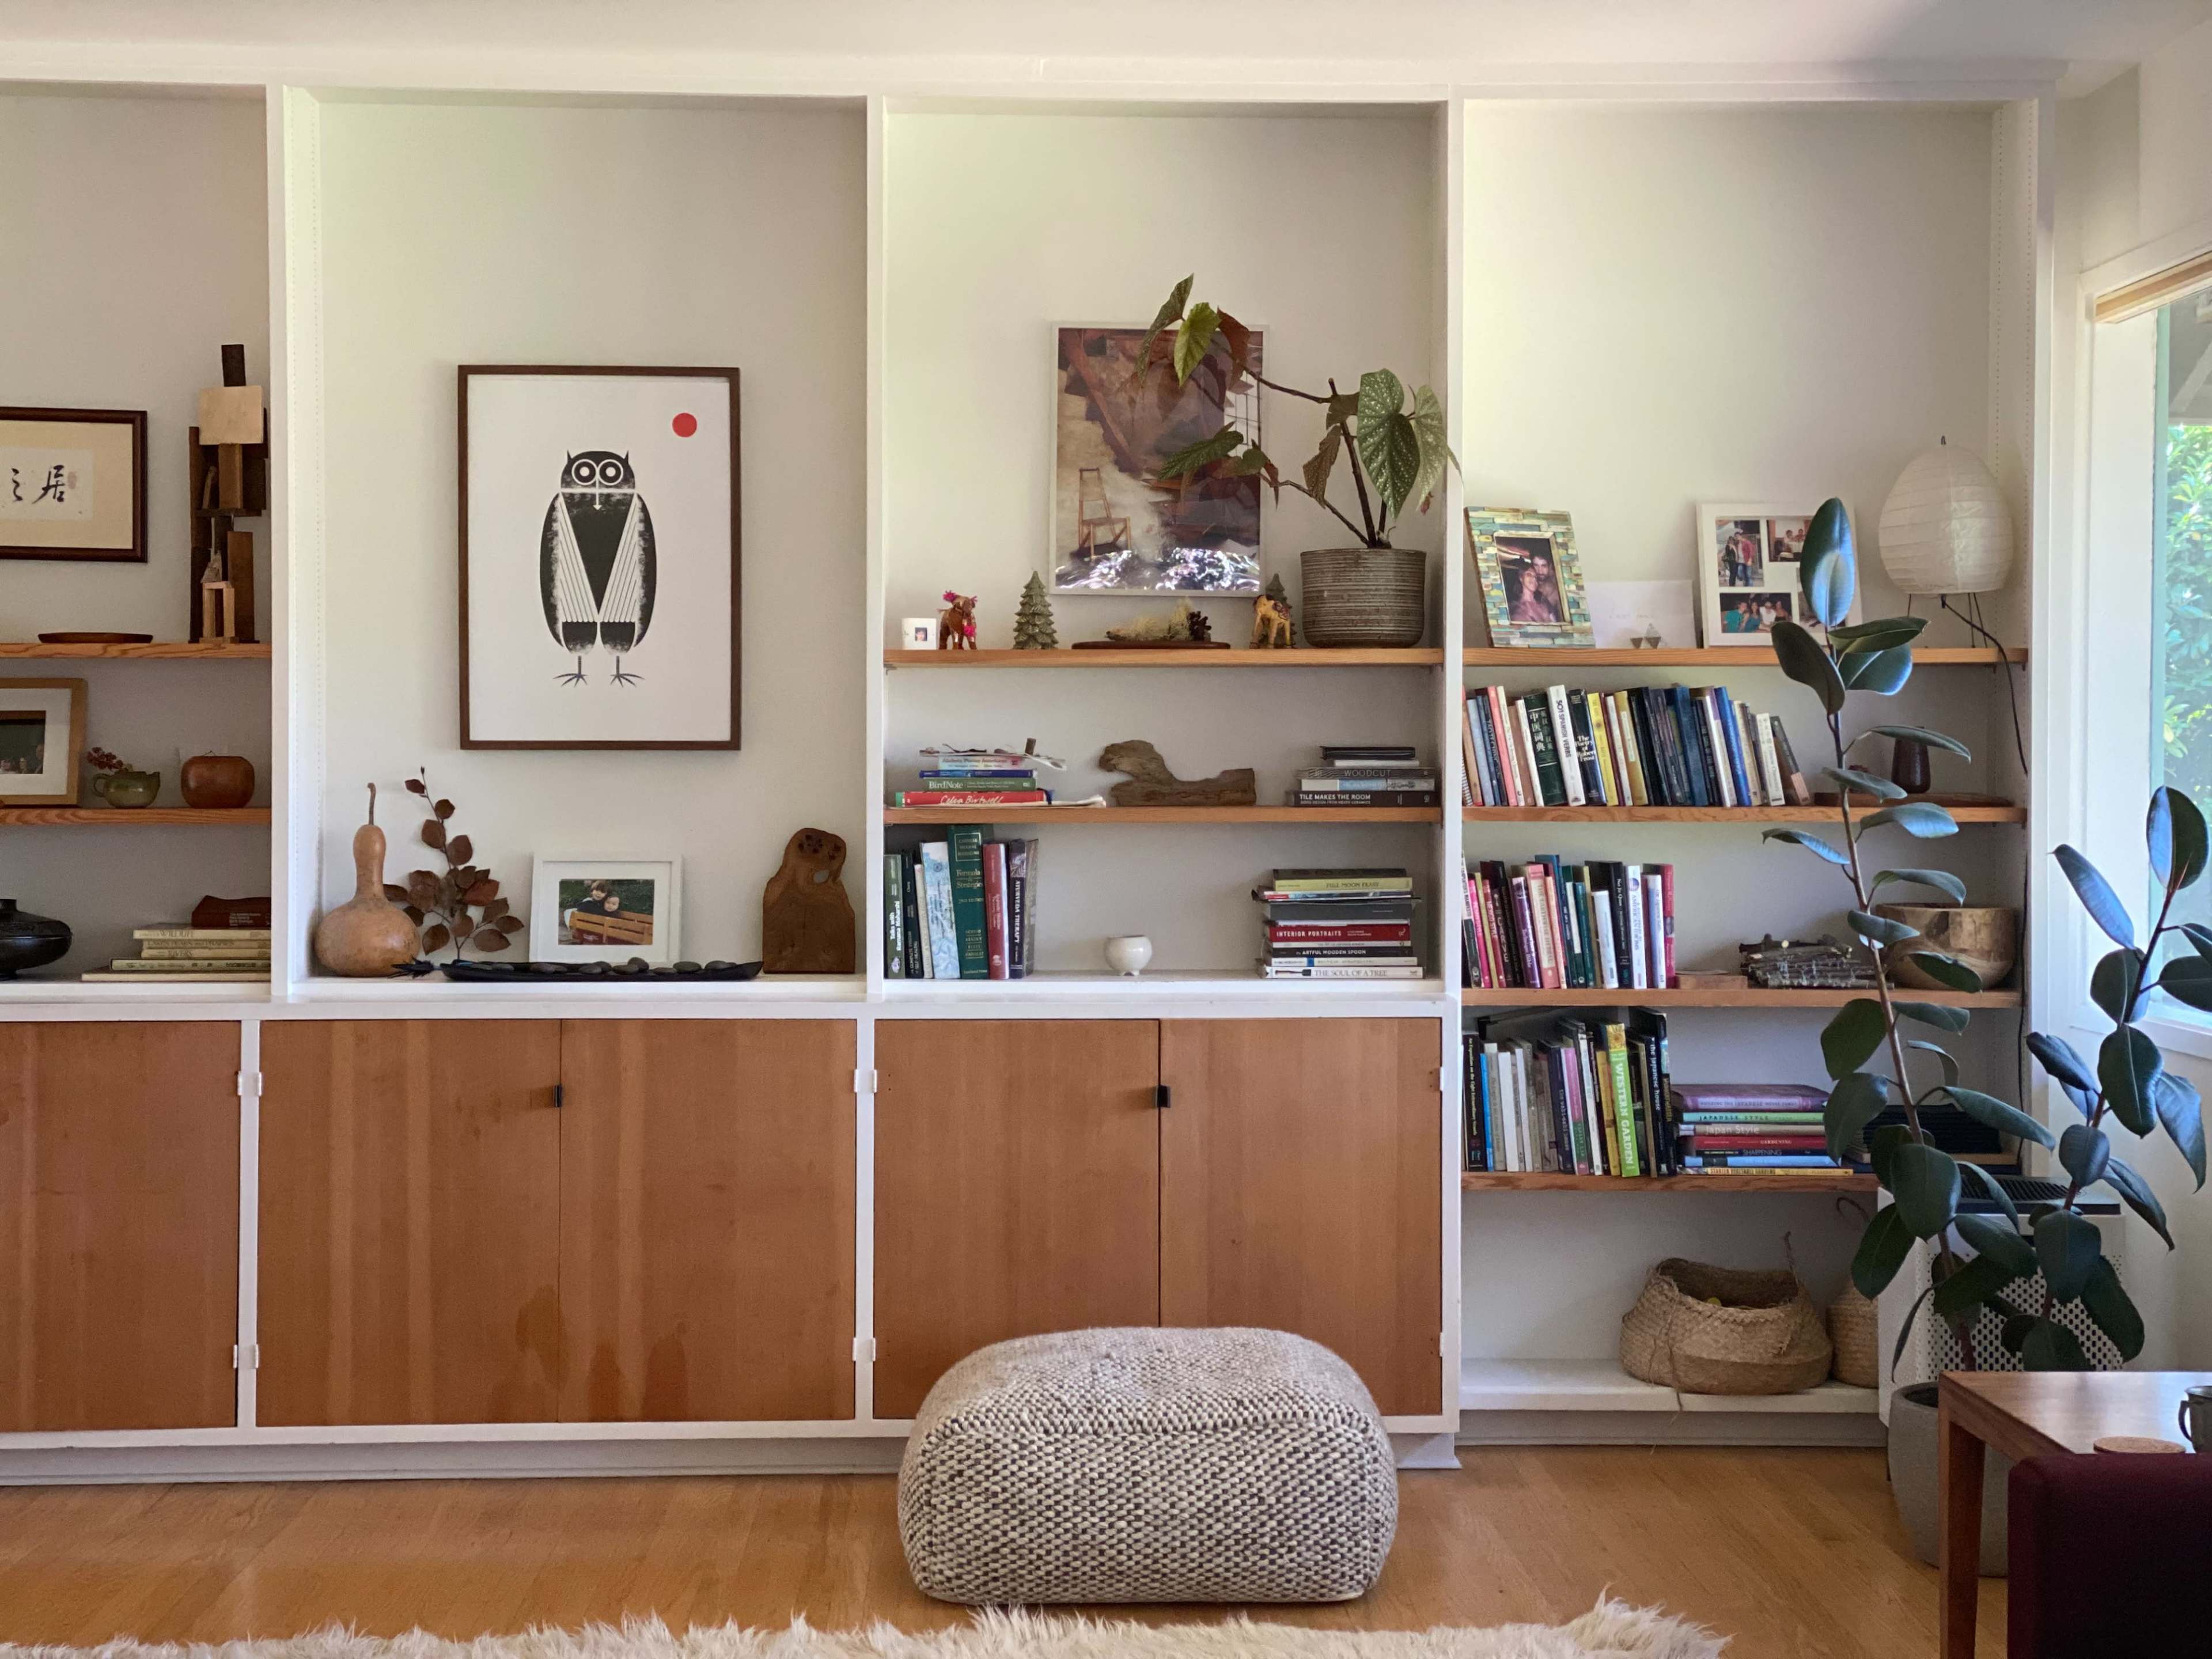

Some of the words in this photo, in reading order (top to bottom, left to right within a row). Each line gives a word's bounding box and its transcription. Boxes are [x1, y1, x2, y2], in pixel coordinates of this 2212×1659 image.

[1559, 713, 1567, 738] SPANISH
[1562, 738, 1571, 758] VERBS
[929, 781, 964, 789] BirdNote
[1344, 769, 1391, 777] WOODCUT
[1486, 901, 1495, 922] MEXICO
[1490, 922, 1498, 937] STYLE
[1498, 916, 1509, 963] CARVE
[1539, 896, 1550, 937] EARTHWISE
[1545, 937, 1554, 963] HERBAL
[1650, 1057, 1658, 1088] japanese
[1615, 1063, 1628, 1116] WESTERN
[1560, 1103, 1569, 1132] wabi-sabi
[1706, 1126, 1733, 1134] Japan
[1736, 1124, 1760, 1134] Style
[1621, 1119, 1634, 1164] GARDEN
